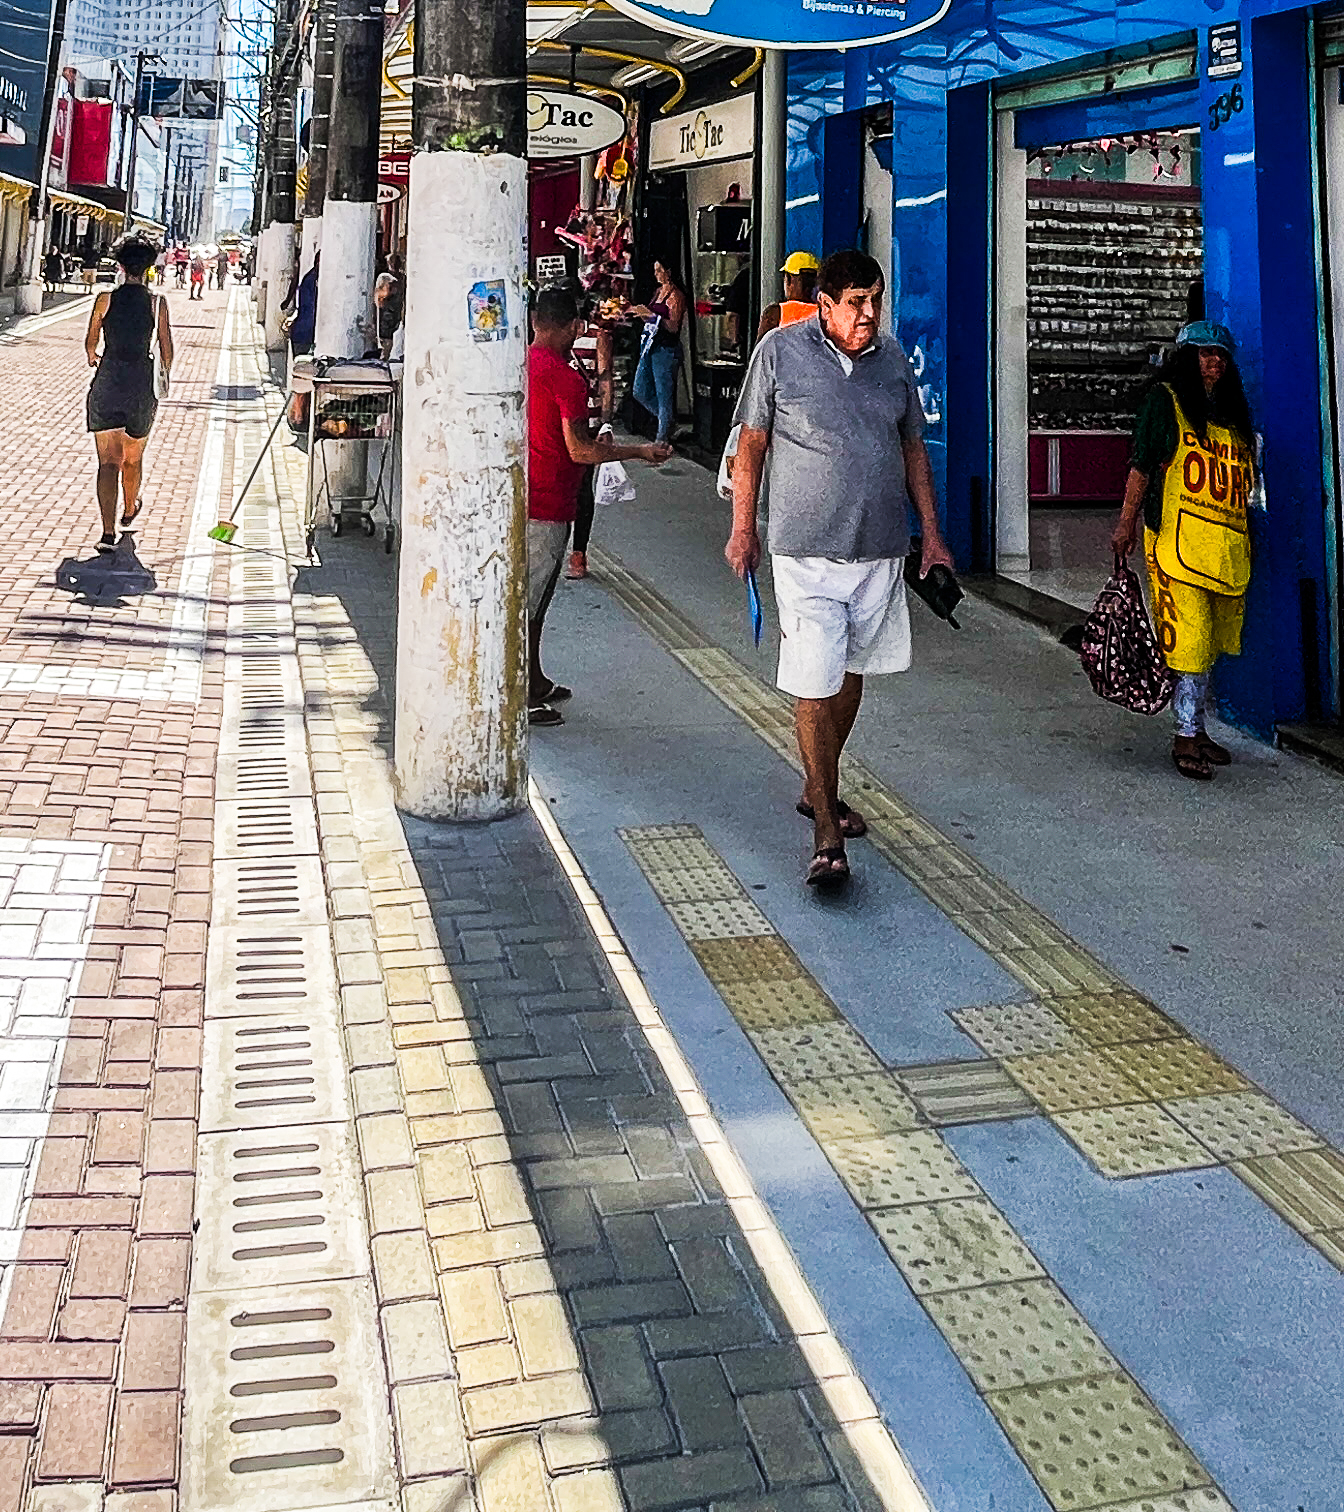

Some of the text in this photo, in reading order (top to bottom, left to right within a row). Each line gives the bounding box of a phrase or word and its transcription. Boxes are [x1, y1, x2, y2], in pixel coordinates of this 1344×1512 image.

[866, 5, 906, 21] Piercing
[541, 102, 594, 128] Tac
[529, 135, 578, 144] elógios
[679, 120, 724, 154] Tic Tac
